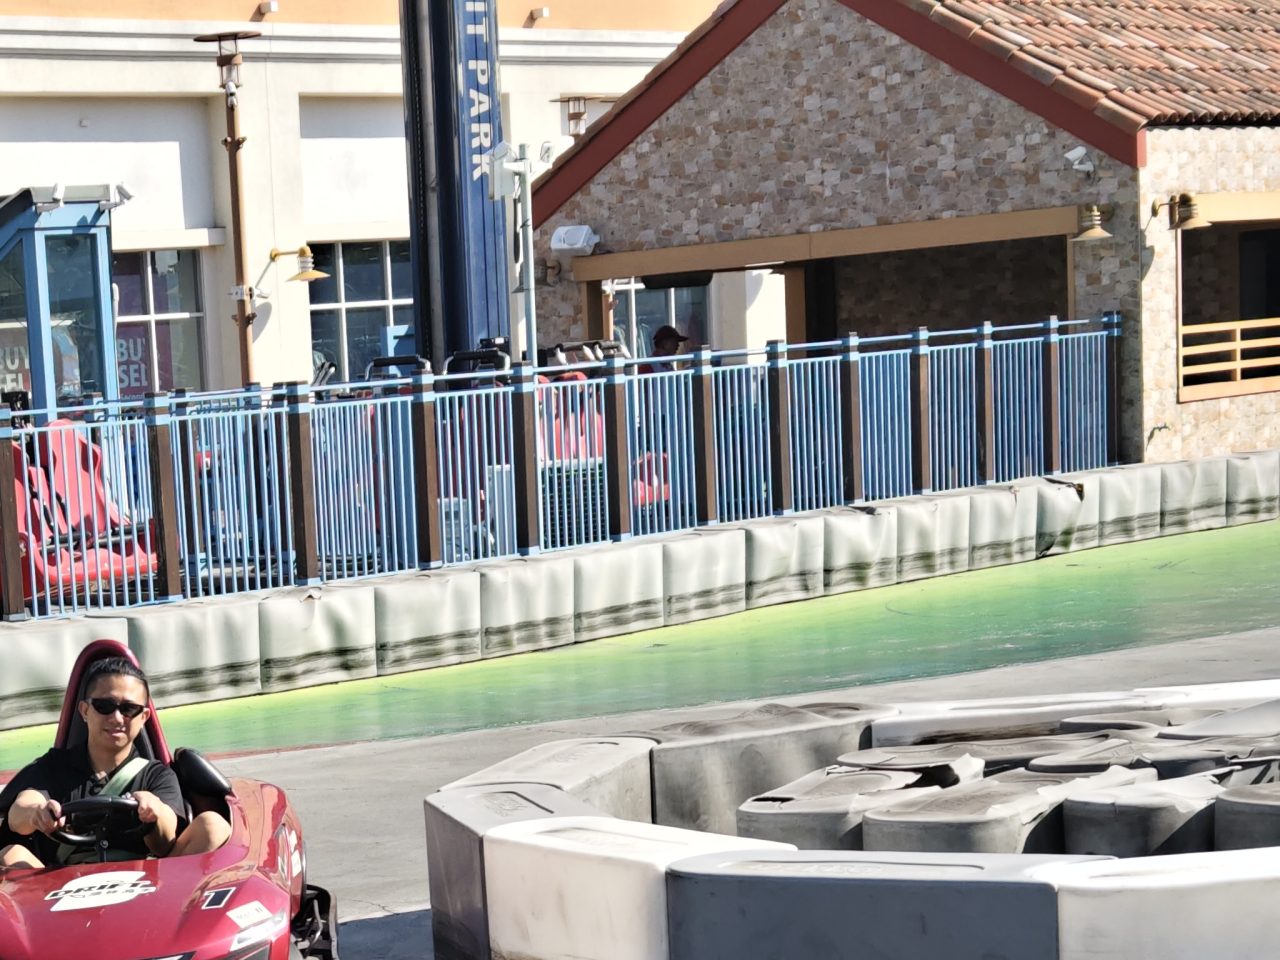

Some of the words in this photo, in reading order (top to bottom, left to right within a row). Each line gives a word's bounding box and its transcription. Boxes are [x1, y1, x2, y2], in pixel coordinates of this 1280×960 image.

[468, 60, 494, 182] PARK
[117, 337, 146, 361] BU
[49, 881, 145, 899] DRIFT
[201, 887, 237, 910] 1
